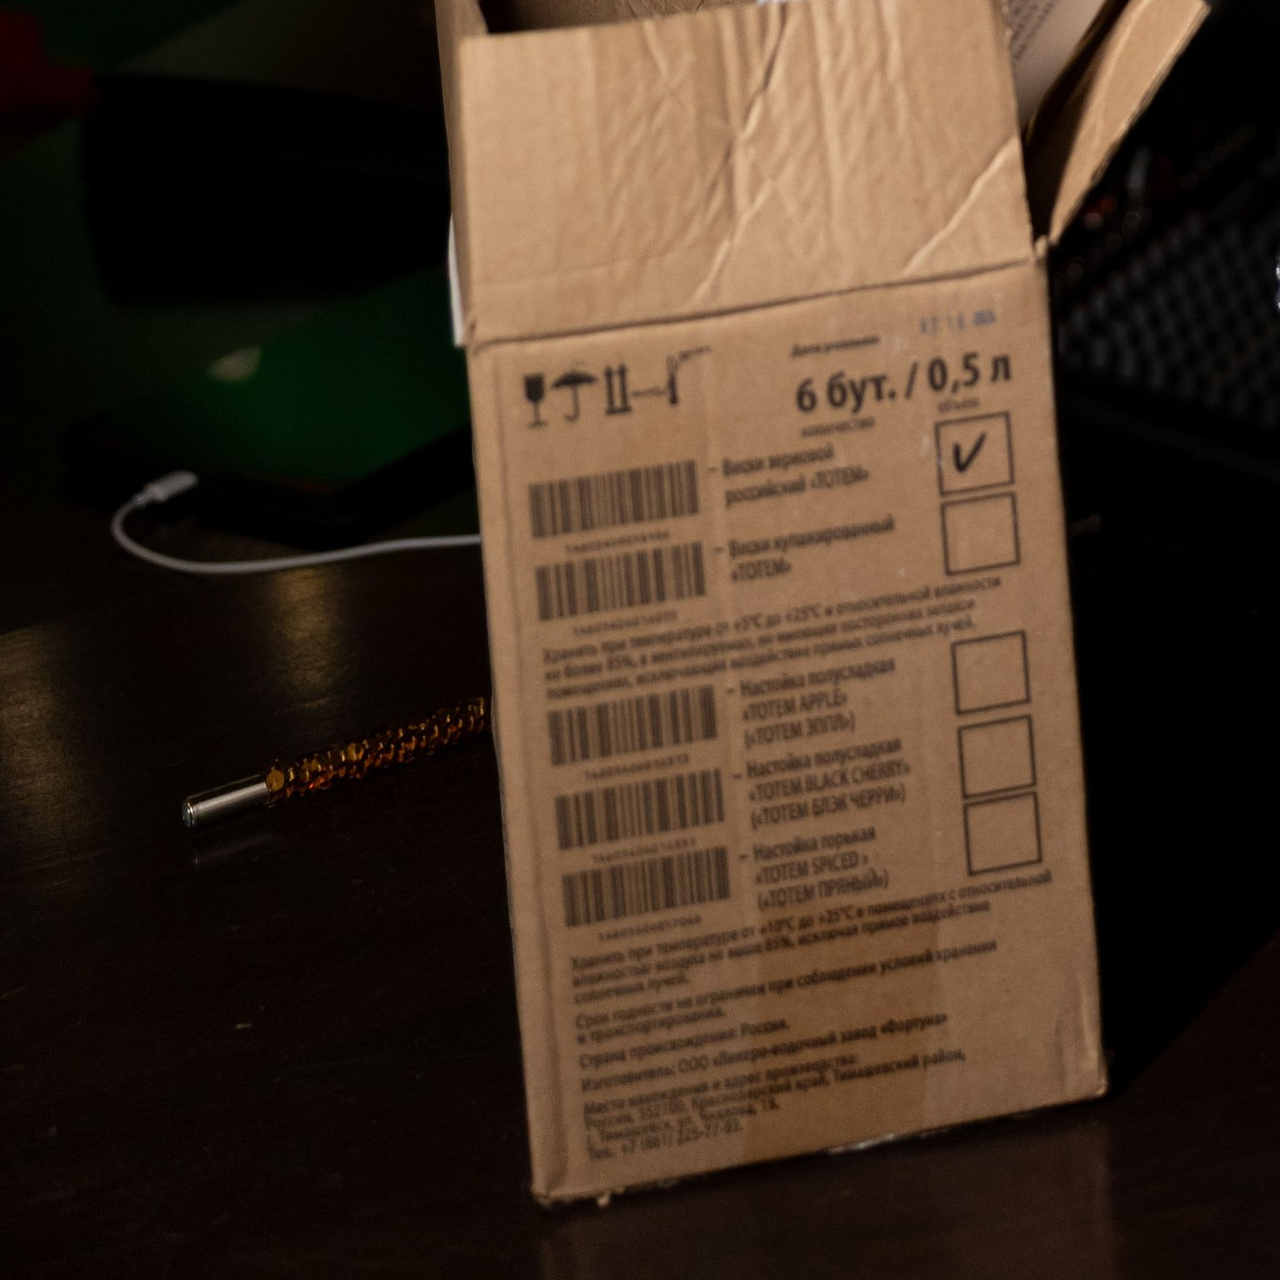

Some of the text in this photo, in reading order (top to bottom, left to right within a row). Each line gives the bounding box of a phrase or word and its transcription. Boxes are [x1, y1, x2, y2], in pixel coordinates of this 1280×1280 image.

[794, 351, 1012, 418] 6 бут. / 0,5 л
[804, 768, 849, 792] BLACK
